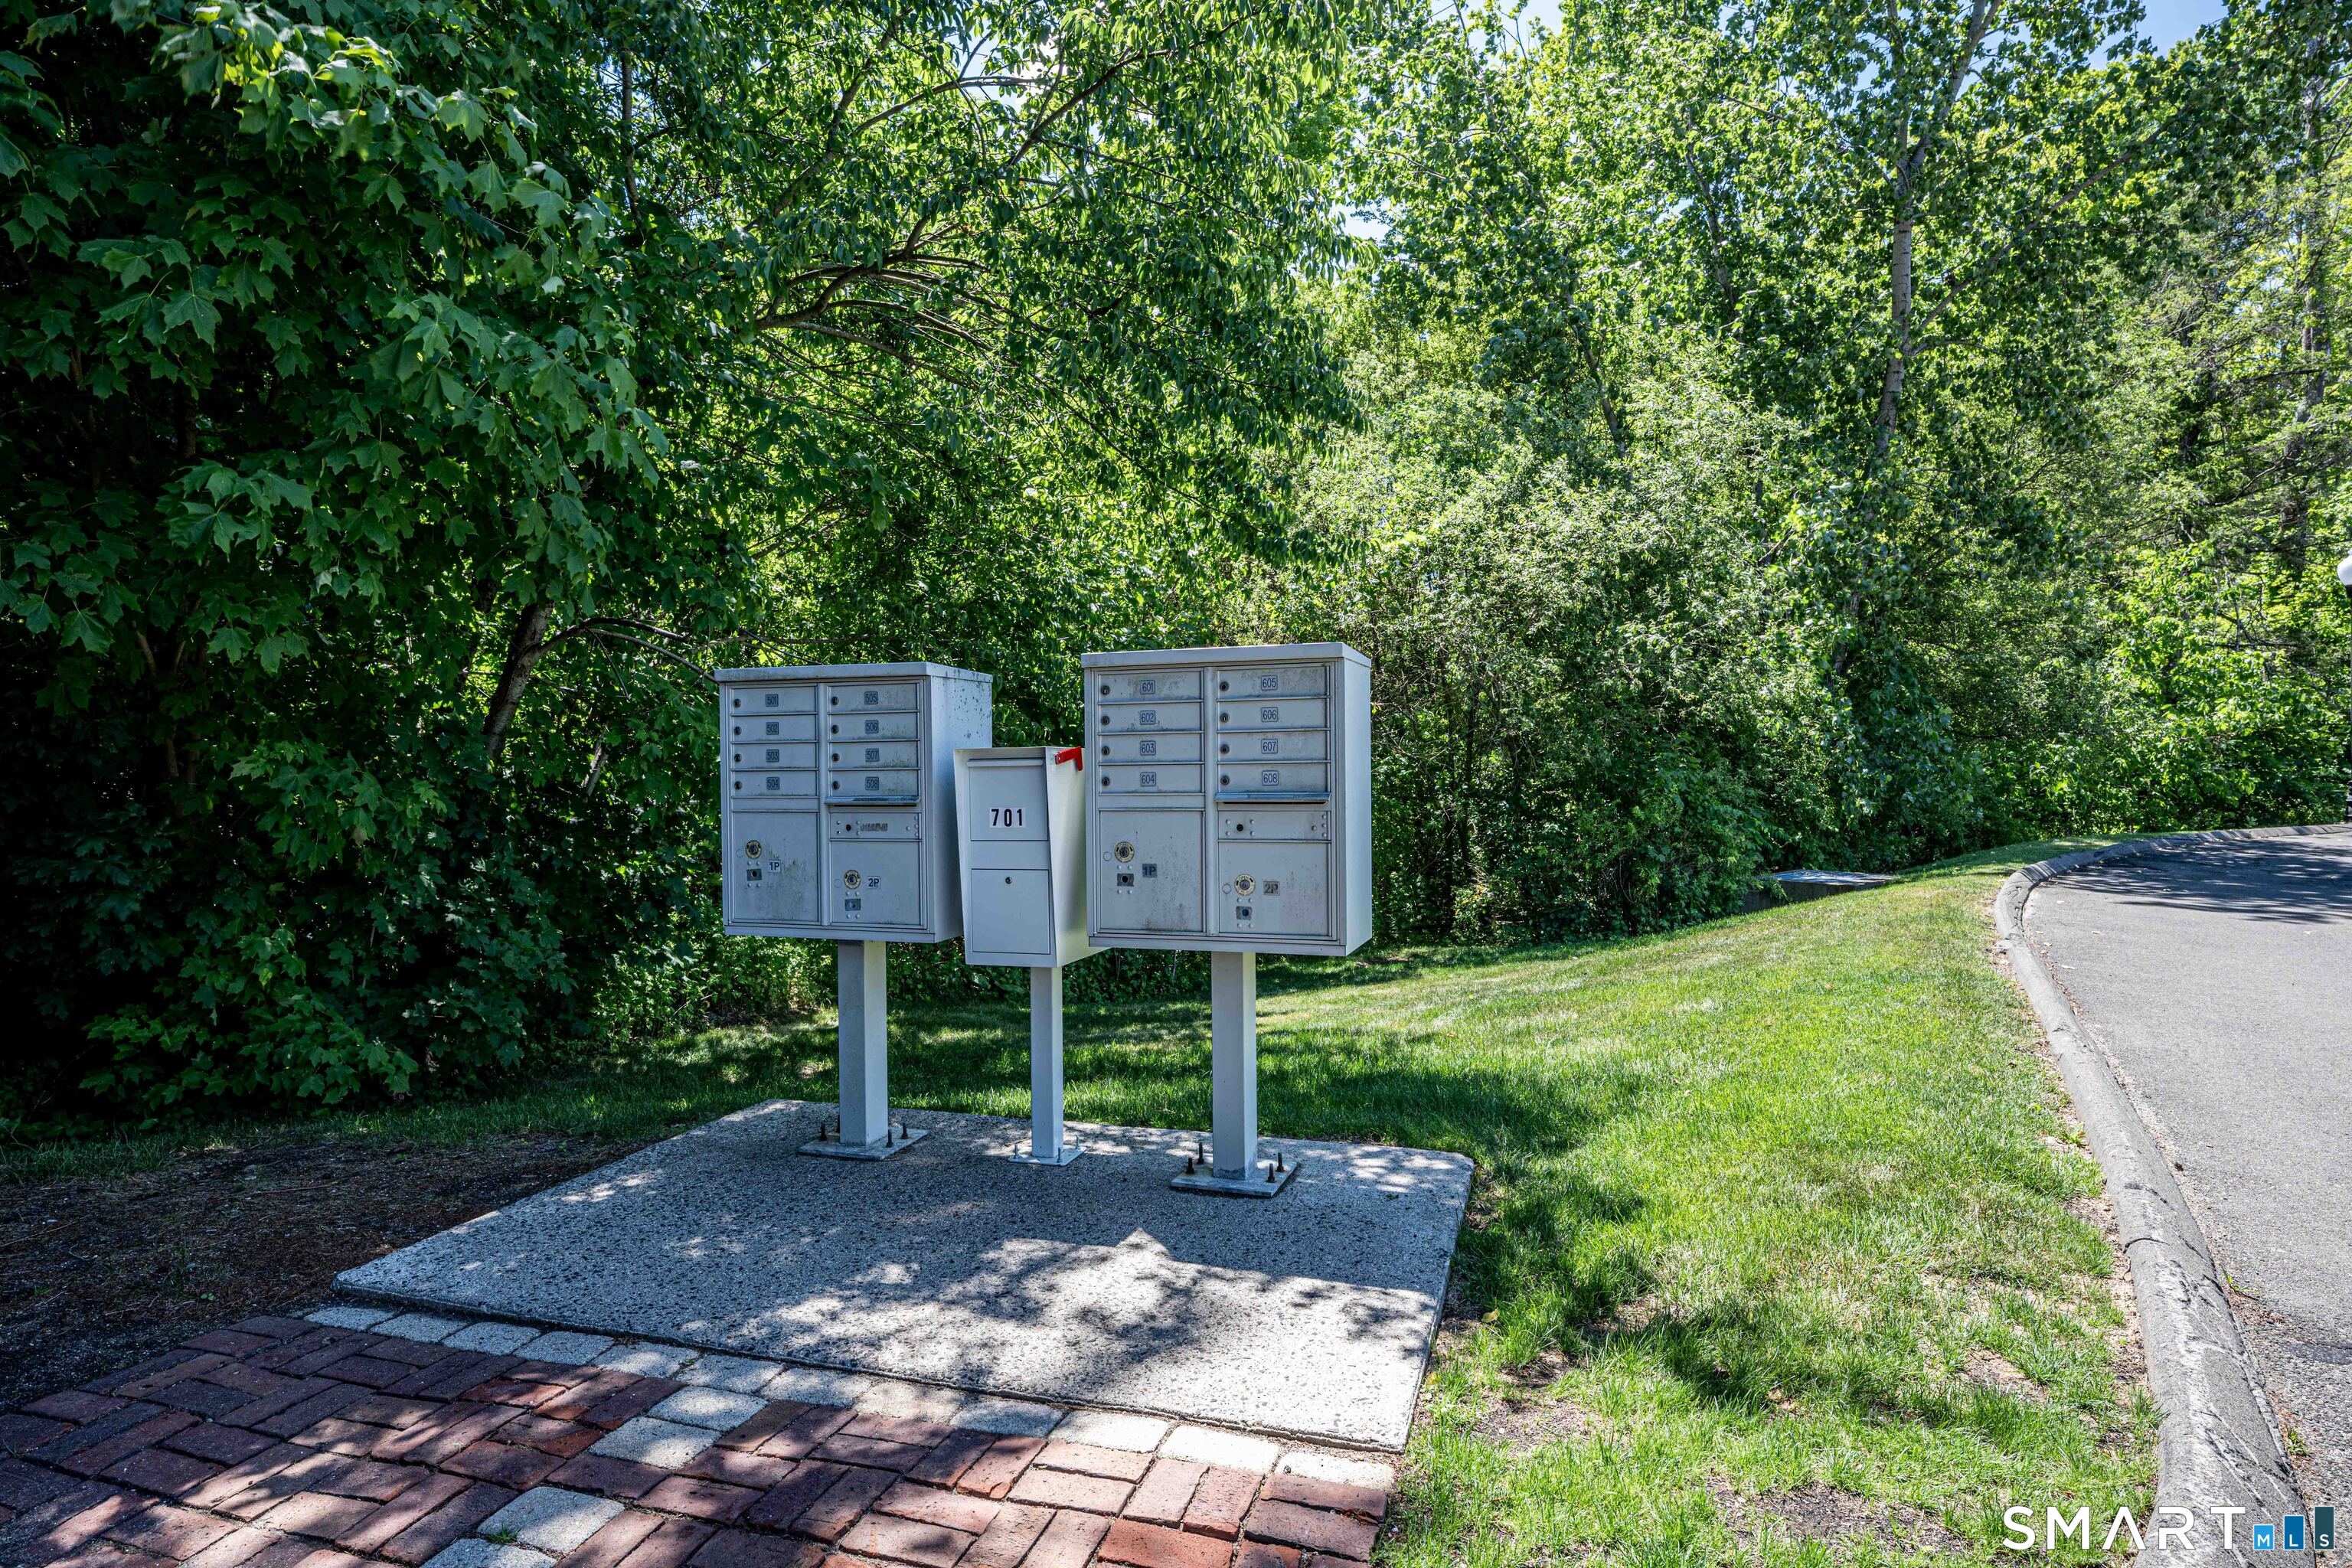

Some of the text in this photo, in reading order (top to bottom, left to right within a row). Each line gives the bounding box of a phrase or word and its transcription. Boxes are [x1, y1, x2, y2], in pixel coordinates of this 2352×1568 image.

[1142, 682, 1154, 693] 601
[1263, 678, 1276, 688] 605
[767, 696, 778, 705] 501
[866, 693, 877, 703] 505
[1141, 713, 1155, 723] 602
[1263, 709, 1277, 720] 606
[766, 724, 778, 733] 502
[866, 722, 877, 732] 506
[1141, 743, 1155, 753] 603
[1263, 741, 1276, 752] 607
[766, 751, 779, 761] 503
[867, 750, 878, 760] 507
[1142, 774, 1155, 784] 604
[1263, 773, 1278, 783] 608
[767, 779, 779, 789] 504
[866, 779, 878, 789] 508
[991, 808, 1022, 827] 701
[769, 862, 779, 871] 1P
[1142, 866, 1156, 876] 1P
[868, 878, 880, 887] 2P
[1264, 884, 1279, 893] 2P
